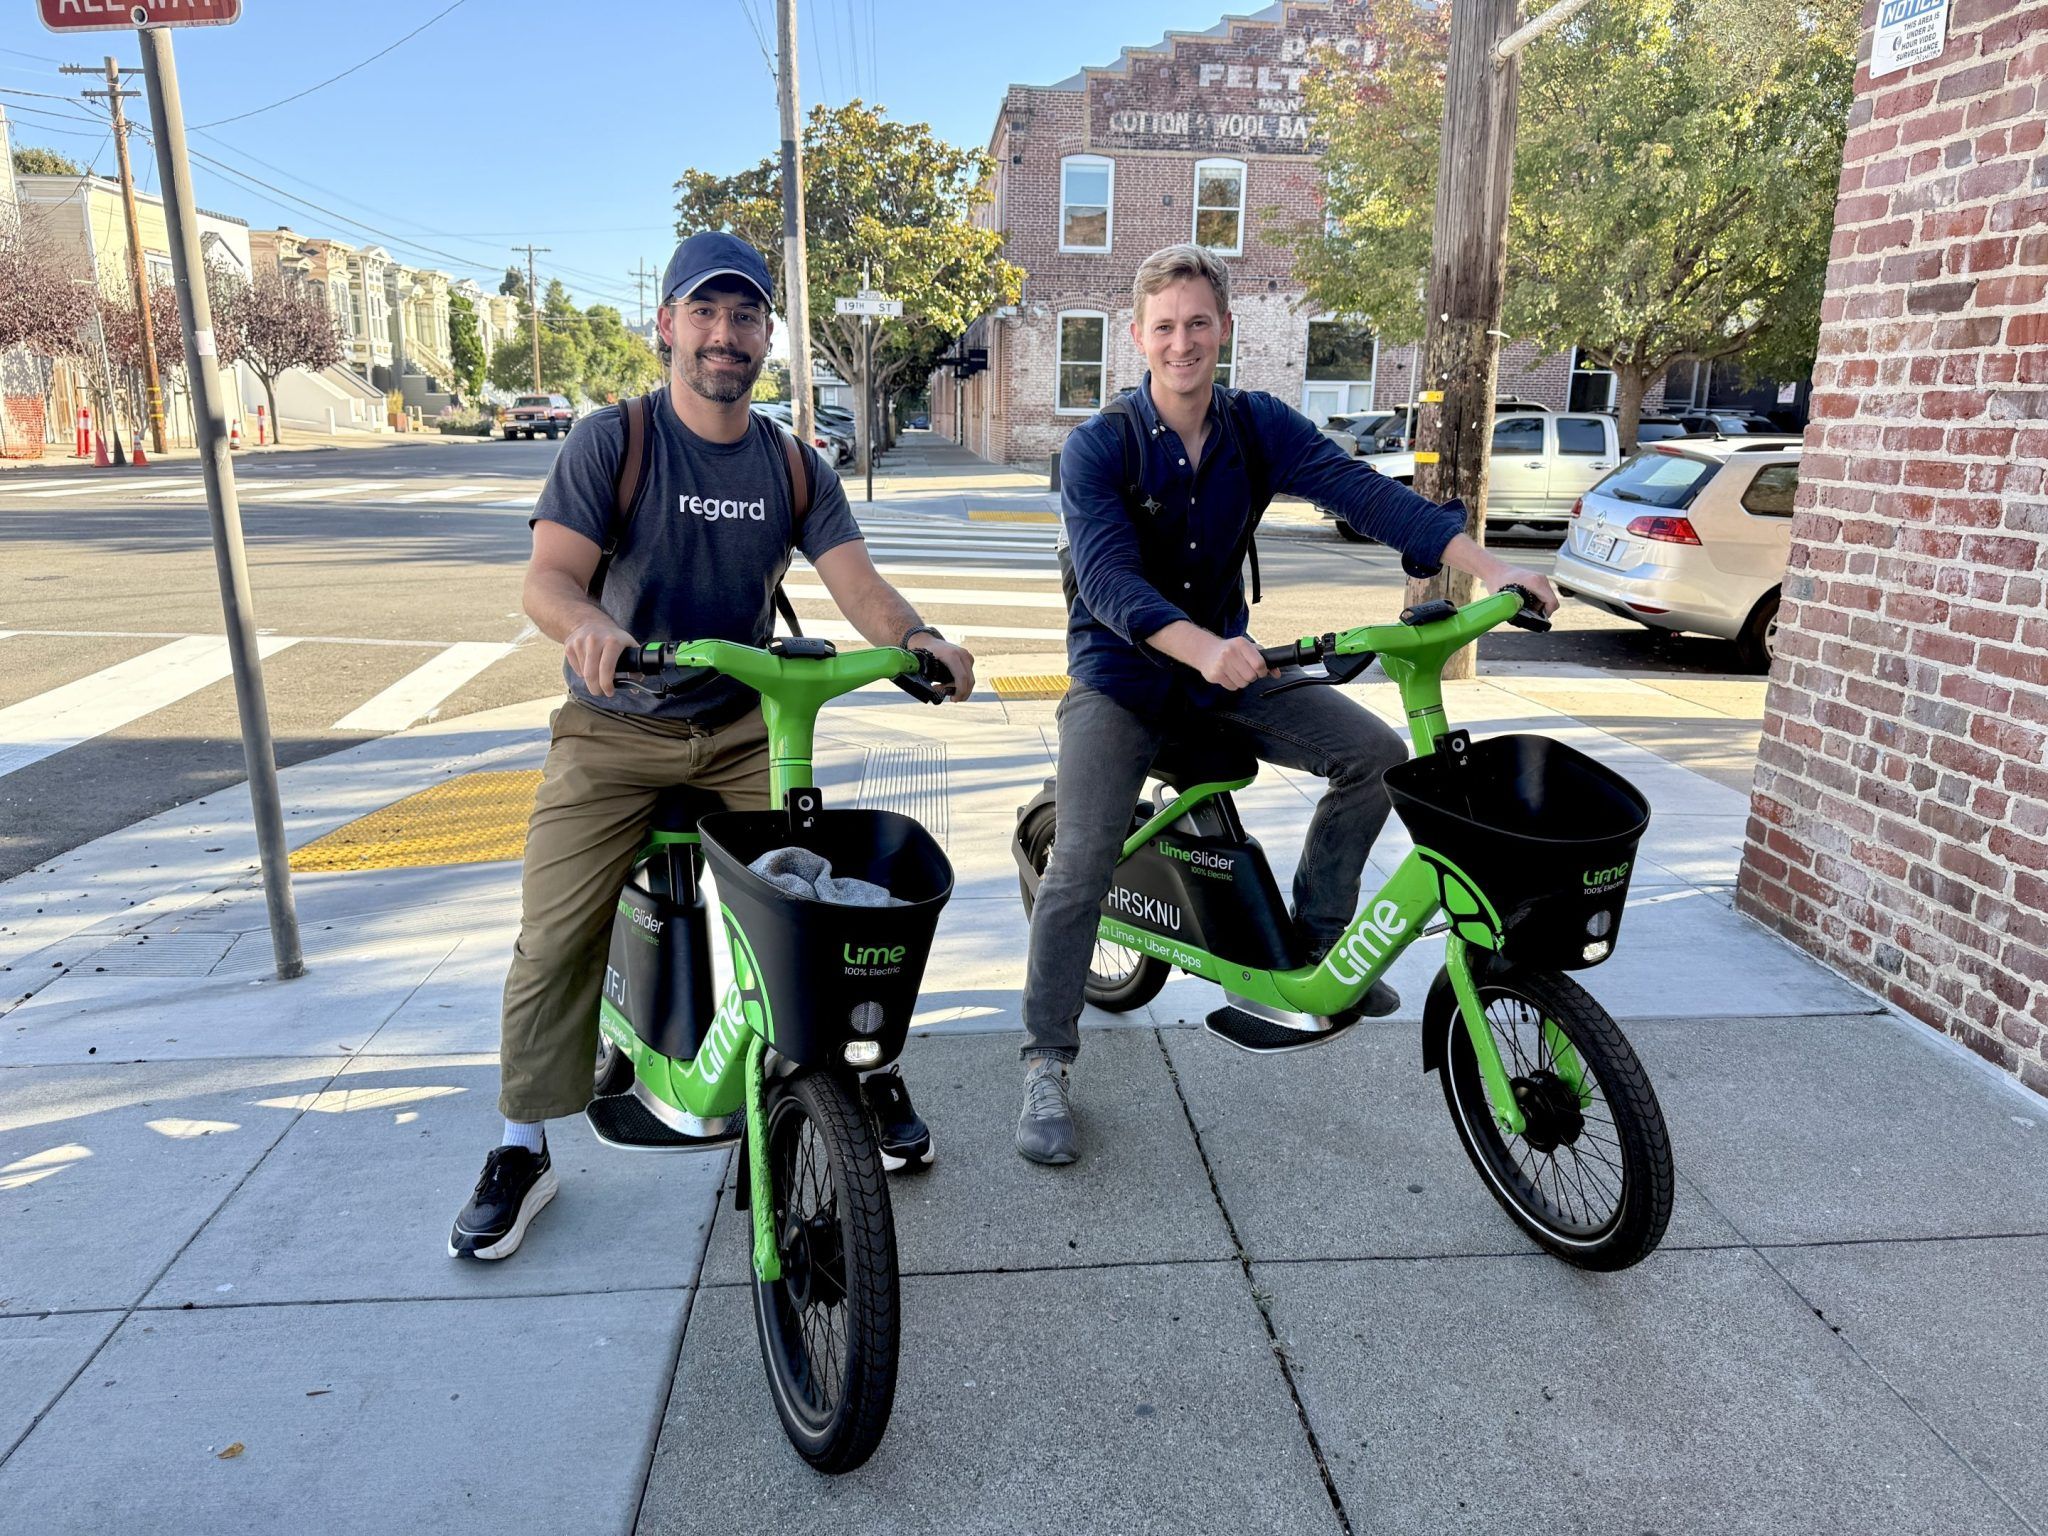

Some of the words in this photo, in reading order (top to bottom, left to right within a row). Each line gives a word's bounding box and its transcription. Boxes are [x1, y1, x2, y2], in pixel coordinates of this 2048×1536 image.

[1904, 20, 1917, 31] THIS
[1918, 15, 1933, 26] AREA
[1934, 11, 1941, 20] IS
[1906, 26, 1926, 39] UNDER
[1927, 23, 1935, 32] 24
[1896, 41, 1940, 61] SURVEILLANCE
[1901, 39, 1918, 50] HOUR
[1919, 32, 1937, 44] VIDEO
[1109, 110, 1190, 135] COTTON
[1212, 114, 1269, 138] WOOL
[879, 303, 892, 312] ST
[679, 494, 765, 521] regard
[1159, 841, 1235, 871] LimeGlider
[1190, 866, 1207, 878] 100%
[1207, 868, 1234, 882] Electric
[1583, 861, 1629, 886] Lime
[1583, 886, 1603, 896] 100%
[1107, 885, 1182, 931] HRSKNU
[843, 942, 906, 966] Lime
[1110, 925, 1135, 945] Lime
[1144, 937, 1171, 957] Uber
[1172, 947, 1202, 969] Apps
[1324, 899, 1407, 986] Lime
[844, 966, 868, 977] 100%
[869, 966, 901, 977] Electric
[603, 964, 626, 1006] TFJ
[699, 982, 746, 1085] Lime
